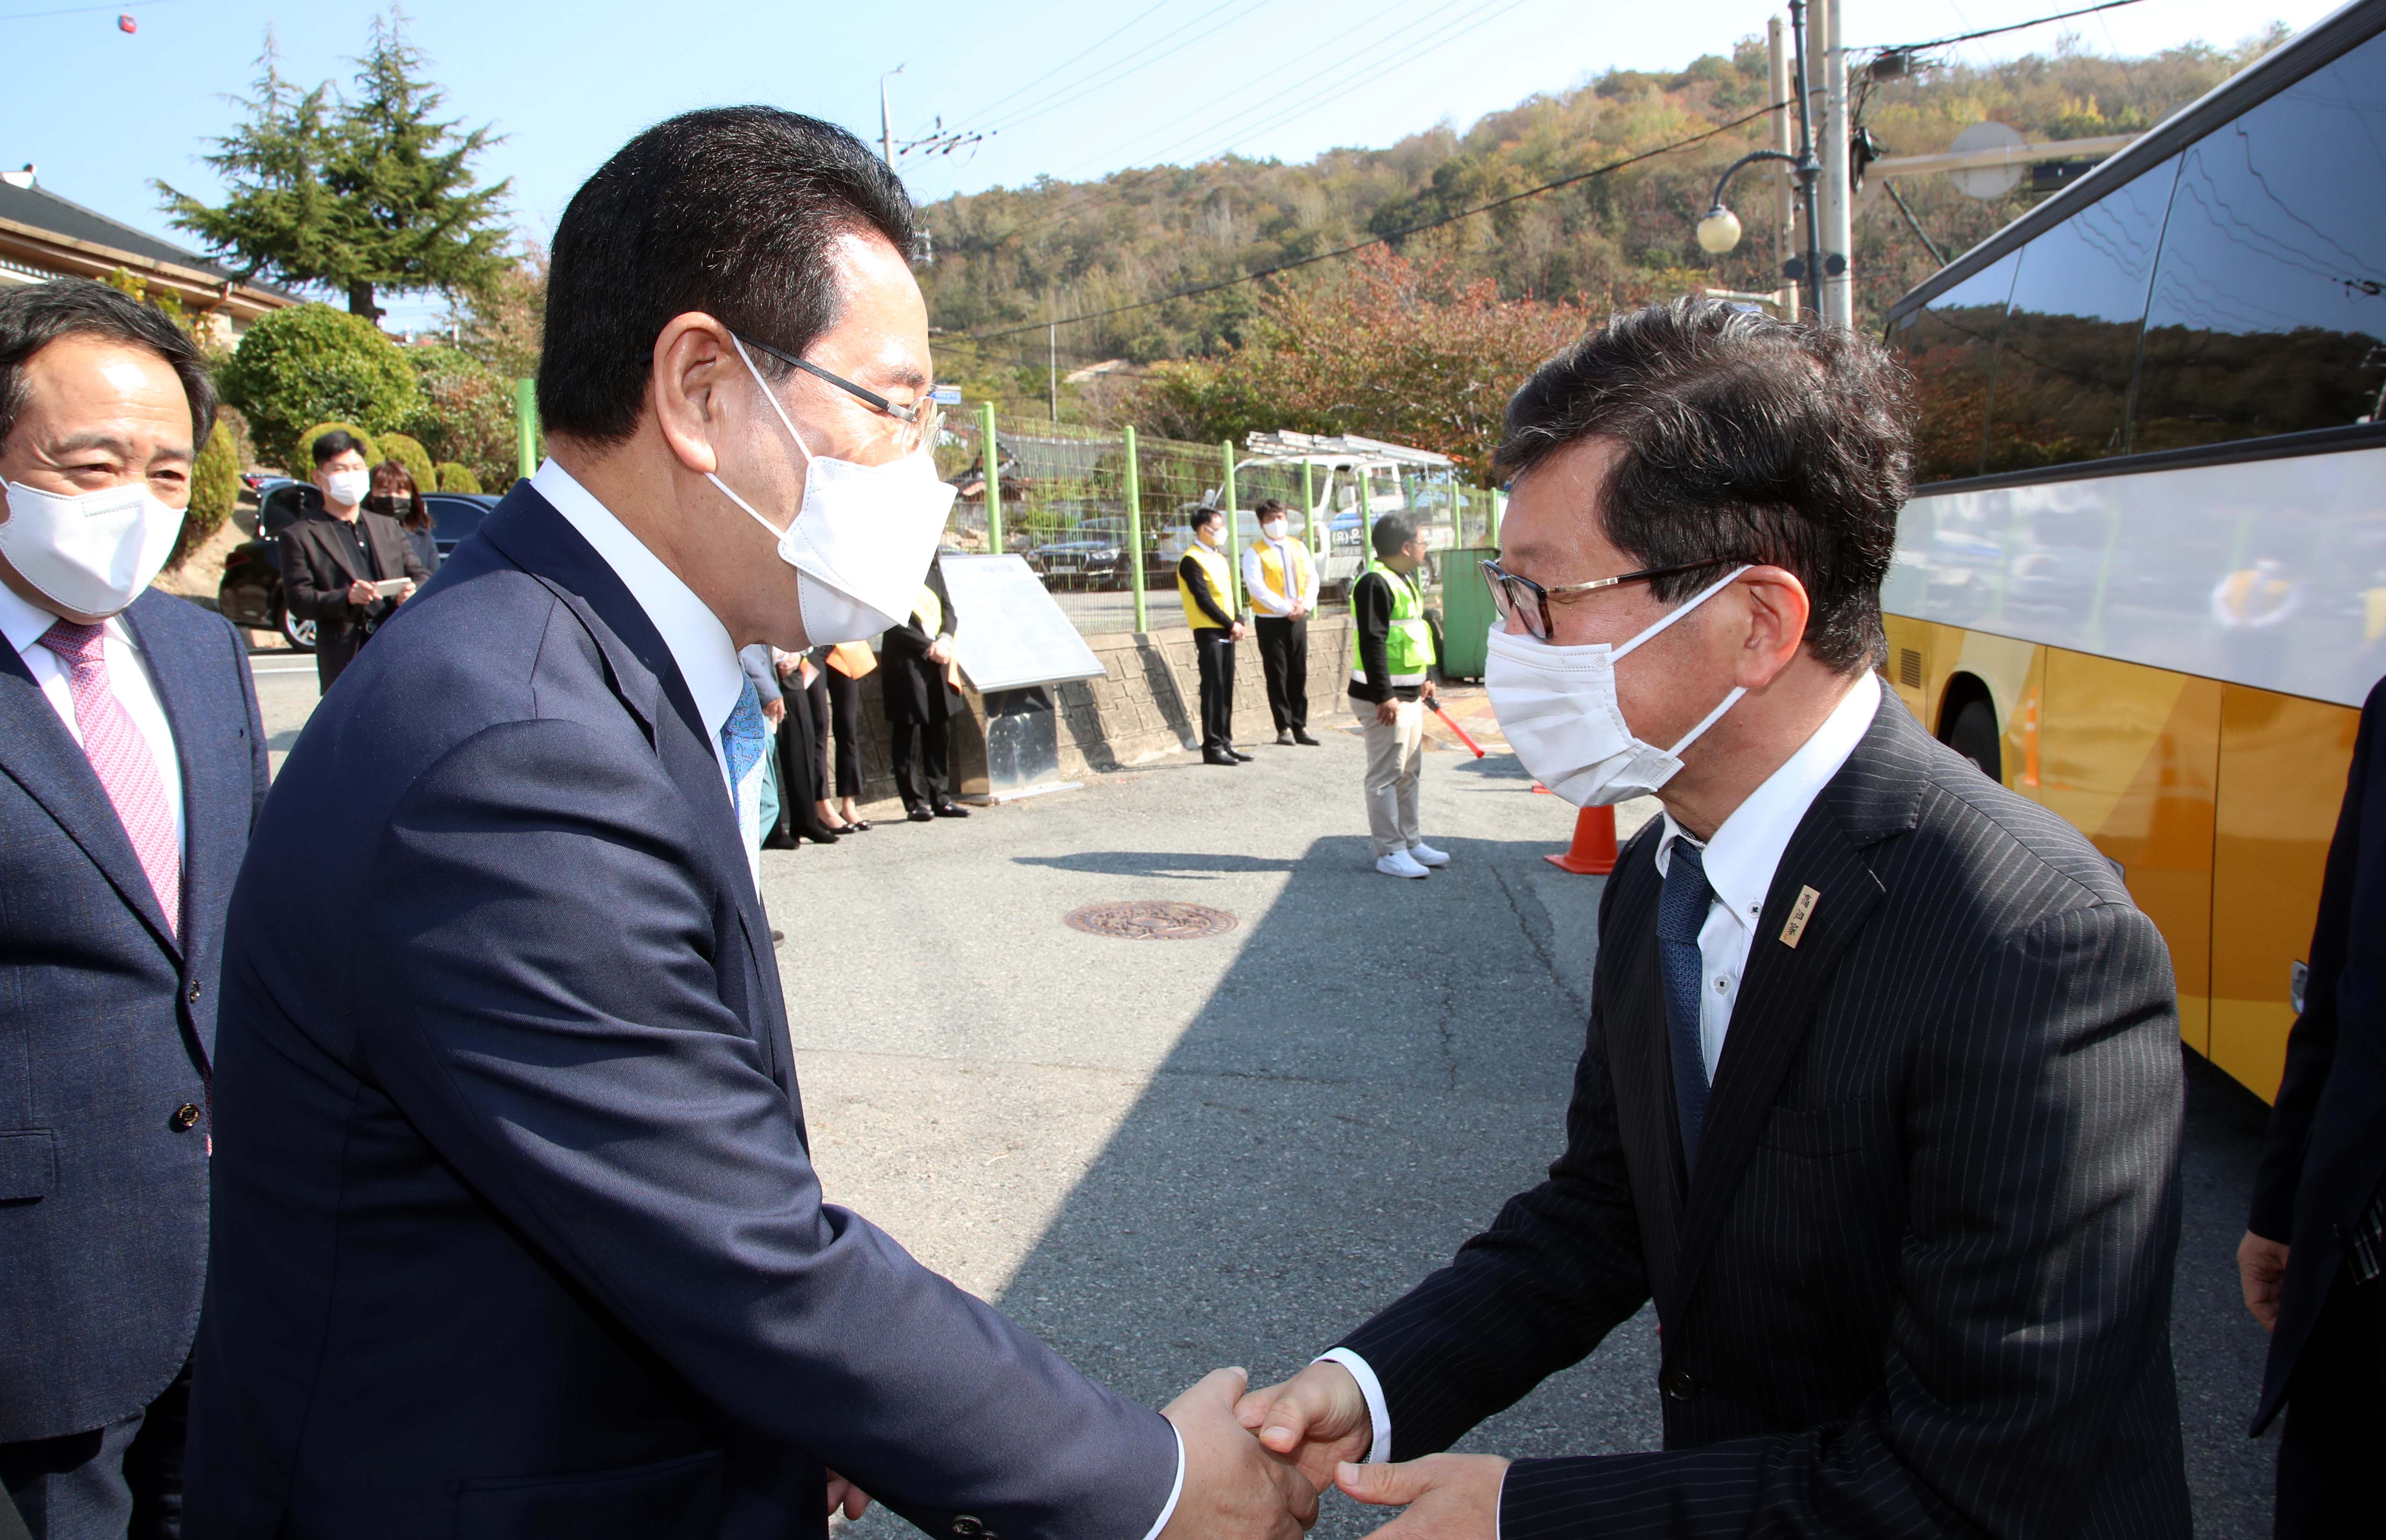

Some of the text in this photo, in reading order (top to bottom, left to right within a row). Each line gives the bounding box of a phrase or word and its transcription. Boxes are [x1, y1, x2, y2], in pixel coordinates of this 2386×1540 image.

[1332, 528, 1363, 545] (유)온
[1789, 893, 1812, 936] 高知家
